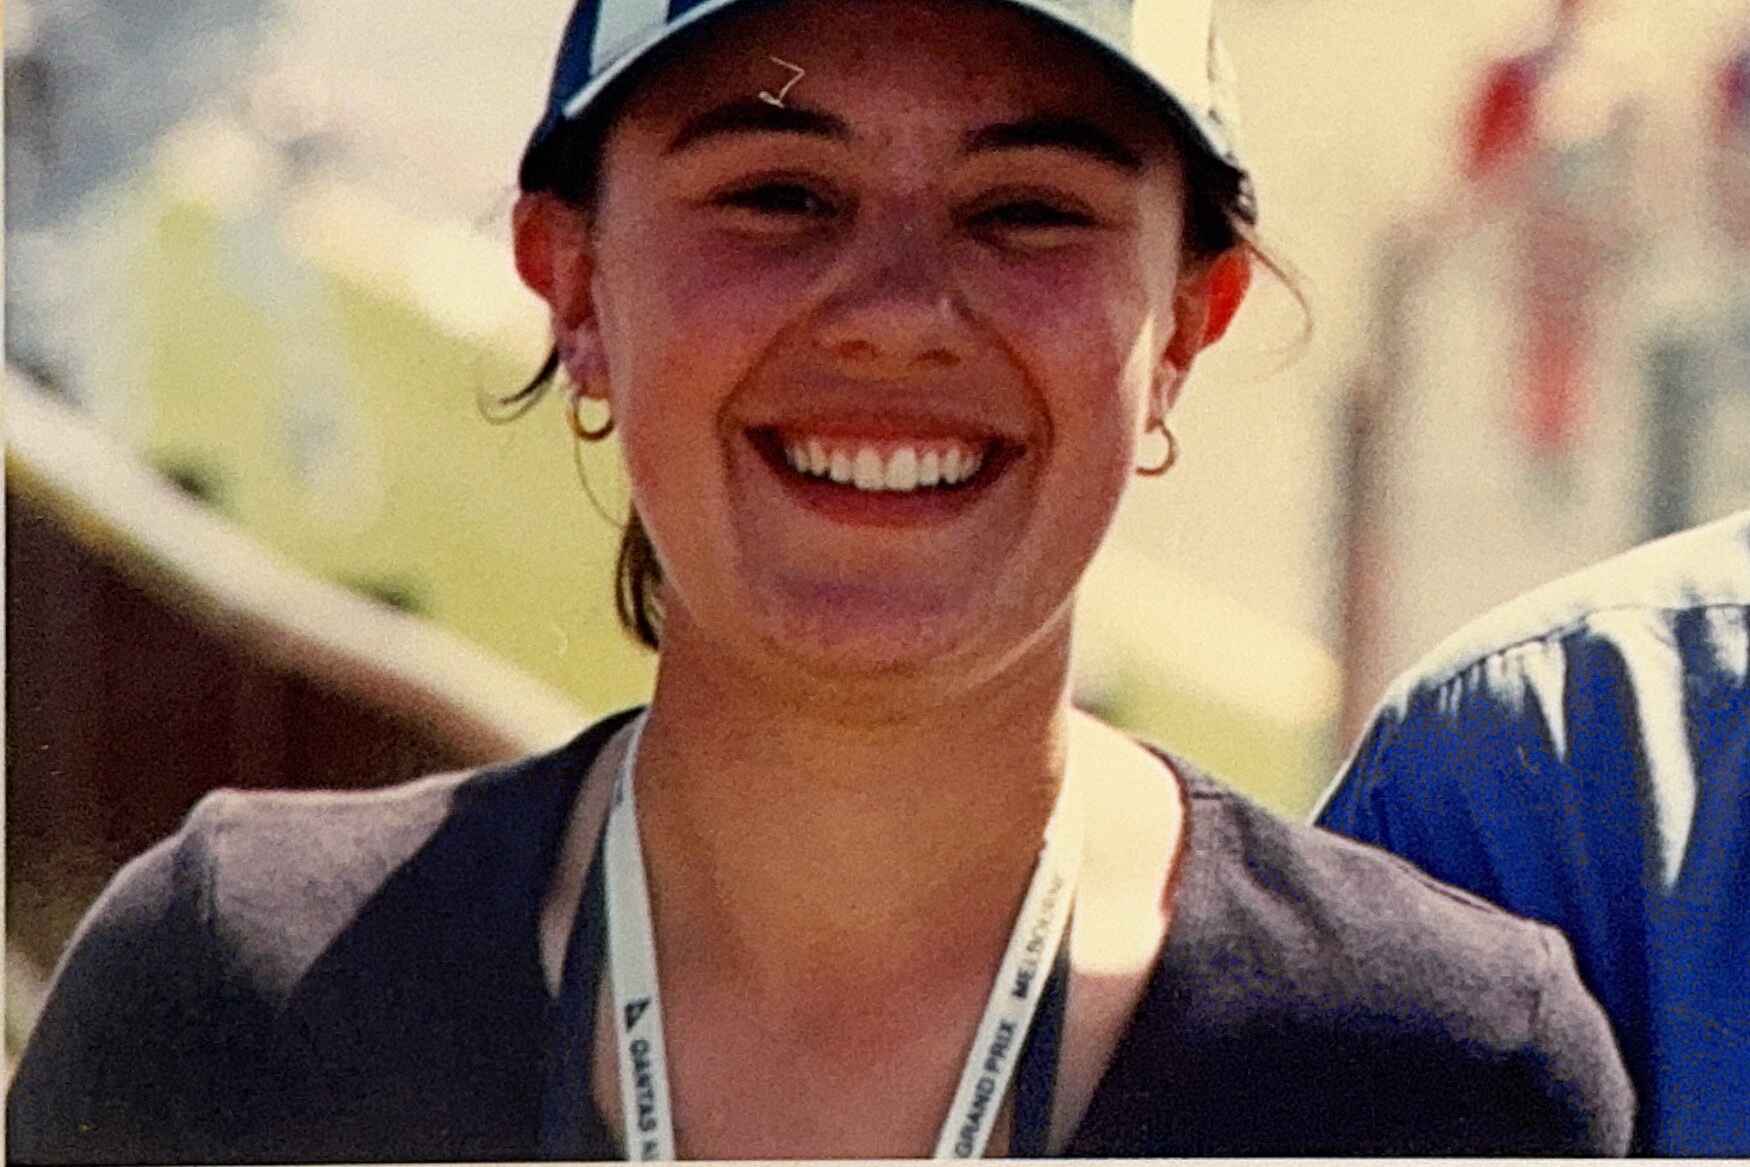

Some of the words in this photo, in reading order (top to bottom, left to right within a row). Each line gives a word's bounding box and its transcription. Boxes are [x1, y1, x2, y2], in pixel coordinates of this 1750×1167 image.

[628, 1038, 660, 1134] QANTAS
[954, 1071, 997, 1159] GRAND
[985, 1020, 1018, 1073] PRIX
